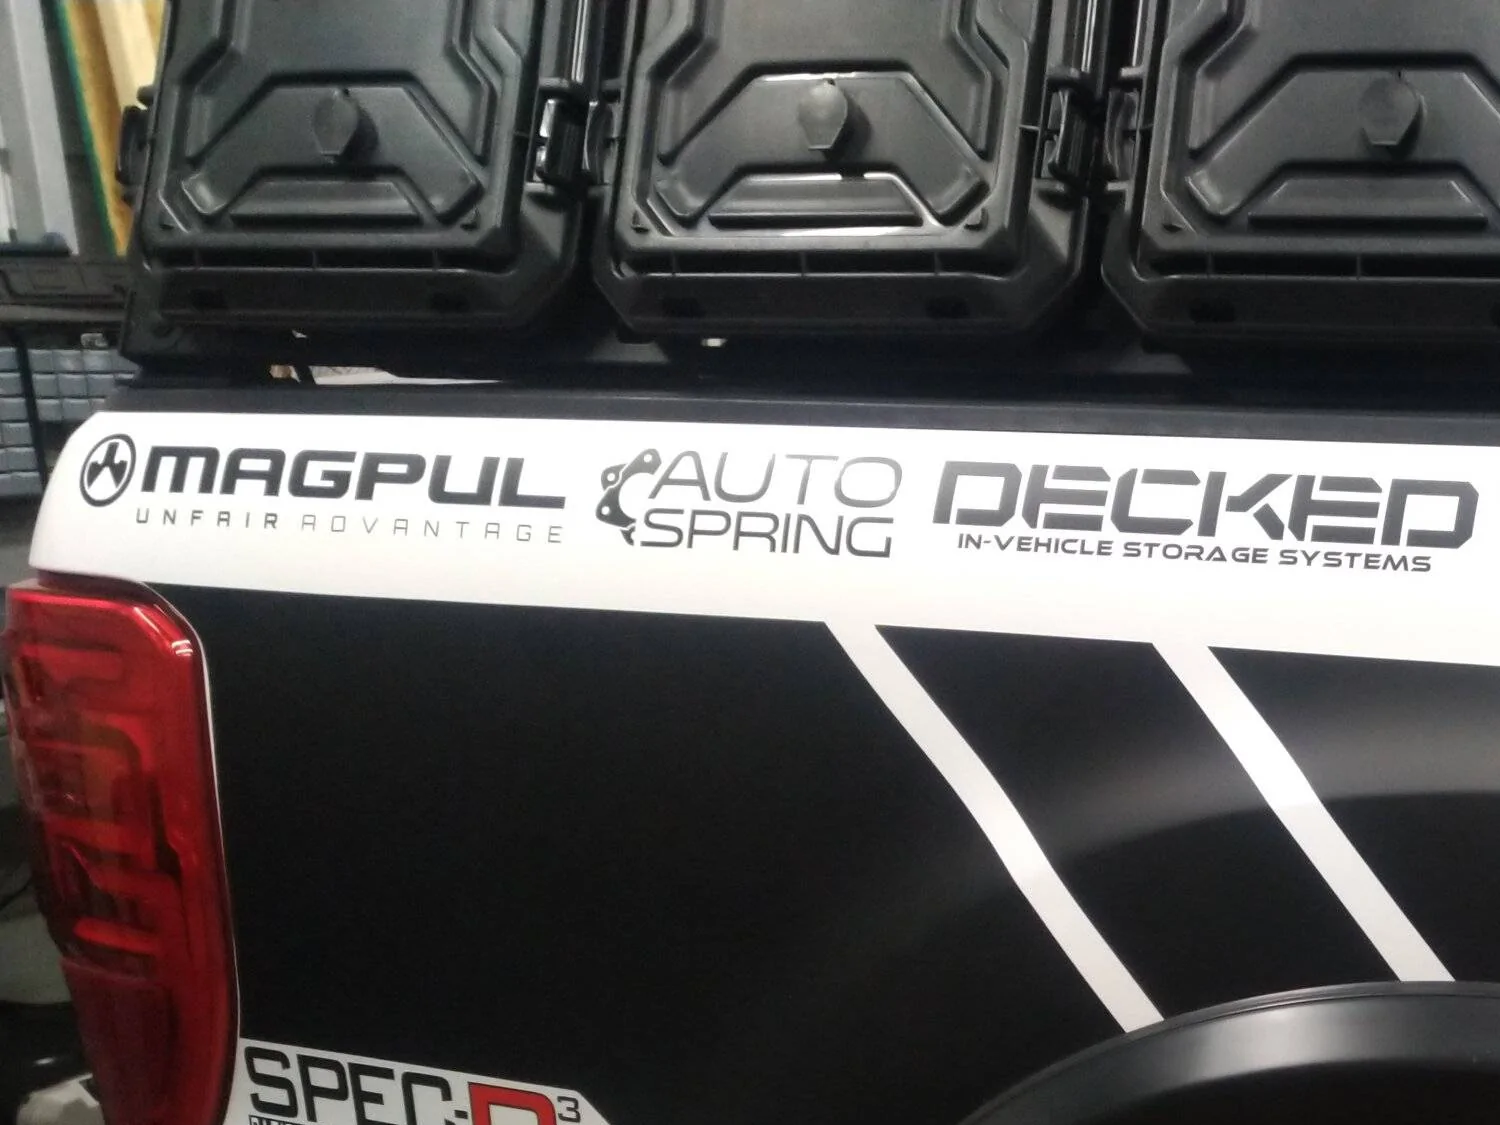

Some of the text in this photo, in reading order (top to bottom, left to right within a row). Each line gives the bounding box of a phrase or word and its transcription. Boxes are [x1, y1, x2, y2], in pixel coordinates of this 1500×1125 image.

[141, 446, 566, 510] MAGPUL
[648, 450, 903, 508] AUTO
[933, 460, 1480, 550] DECKED
[136, 508, 564, 545] UNFAIR ADVANTAGE
[640, 508, 895, 558] SPRING
[957, 533, 1432, 573] IN-VEHICLE STORAGE SYSTEMS
